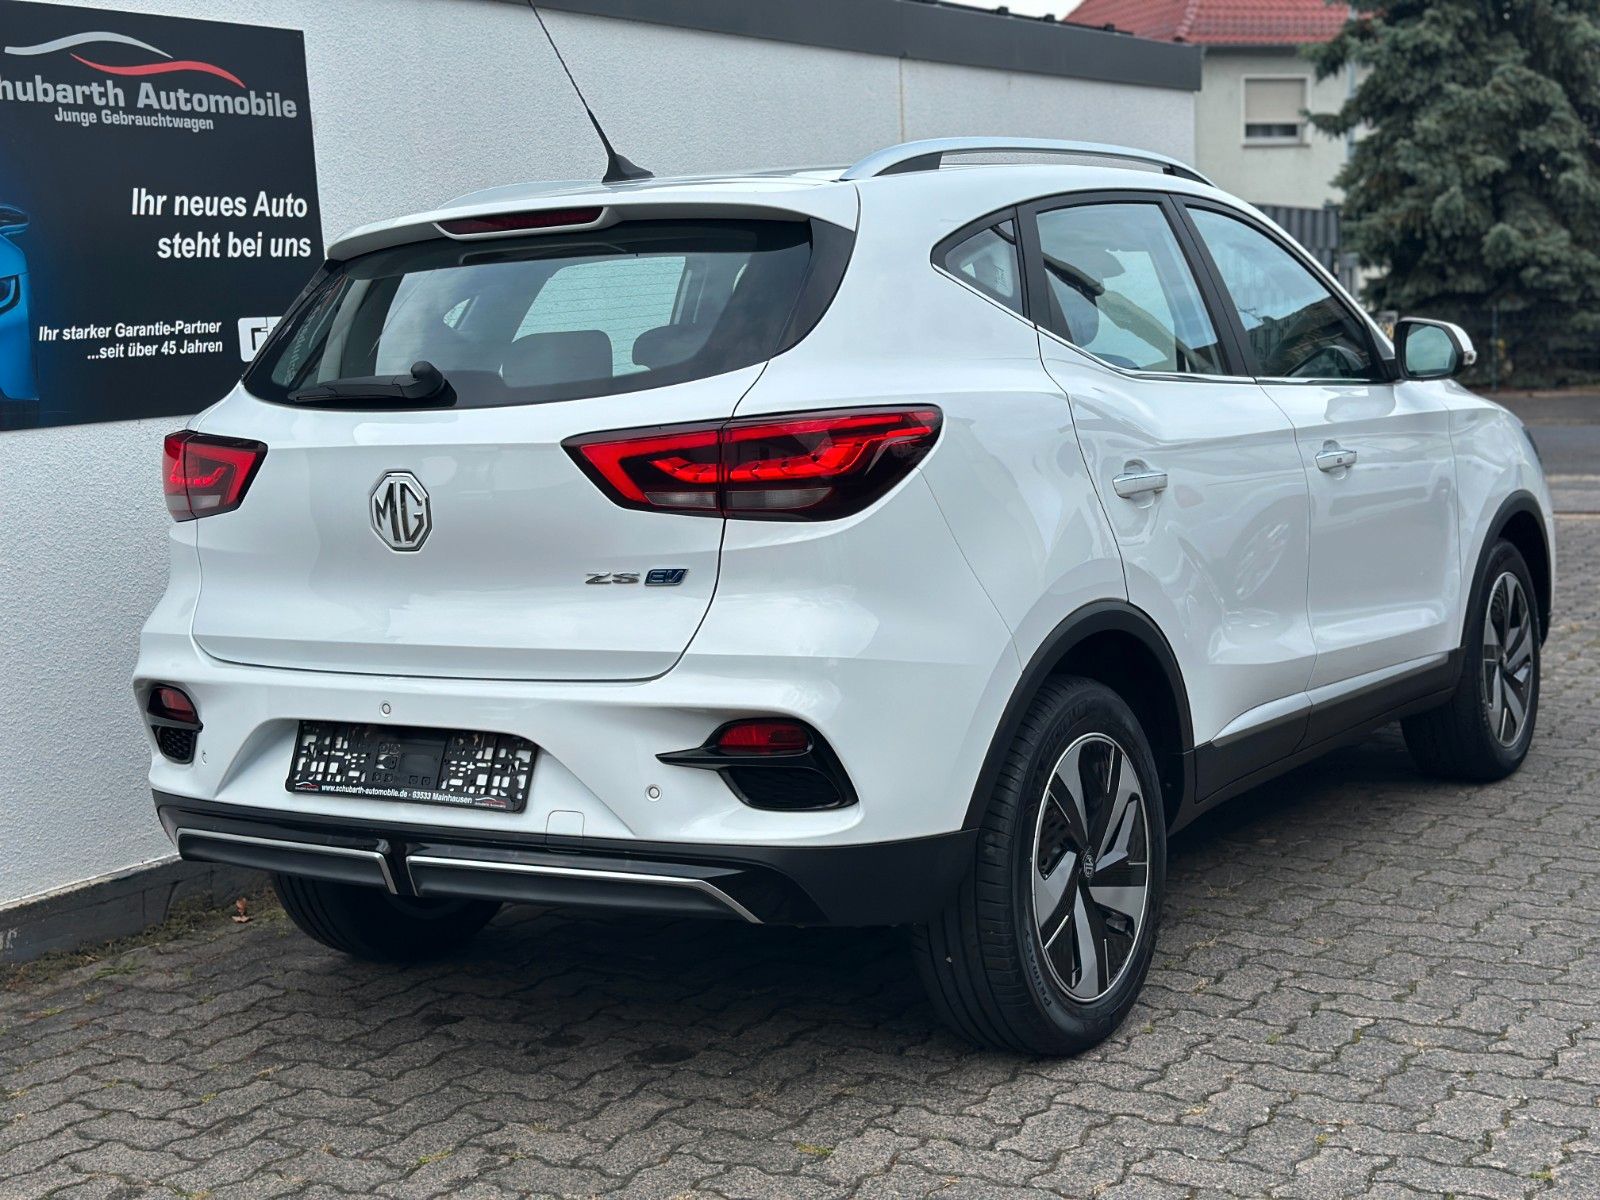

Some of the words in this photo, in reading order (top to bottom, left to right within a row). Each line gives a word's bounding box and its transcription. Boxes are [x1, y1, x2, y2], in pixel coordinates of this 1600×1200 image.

[137, 82, 298, 118] Automobile
[54, 107, 97, 127] Junge
[101, 110, 214, 132] Gebrauchtwagen
[131, 188, 166, 215] Ihr
[174, 195, 247, 217] neues
[253, 191, 307, 218] Auto
[157, 232, 220, 258] steht
[227, 232, 263, 257] bei
[269, 237, 311, 257] uns
[38, 326, 59, 341] Ihr
[62, 324, 111, 340] starker
[114, 320, 222, 338] Garantie-Partner
[87, 343, 124, 359] ...seit
[128, 342, 157, 357] über
[161, 341, 177, 355] 45
[179, 340, 223, 355] Jahren
[373, 478, 427, 545] MG
[585, 571, 640, 585] ZS
[646, 569, 687, 585] EV
[321, 785, 407, 797] www.schubarth-automobile.de
[412, 790, 432, 800] 63533
[432, 793, 473, 804] Mainhausen
